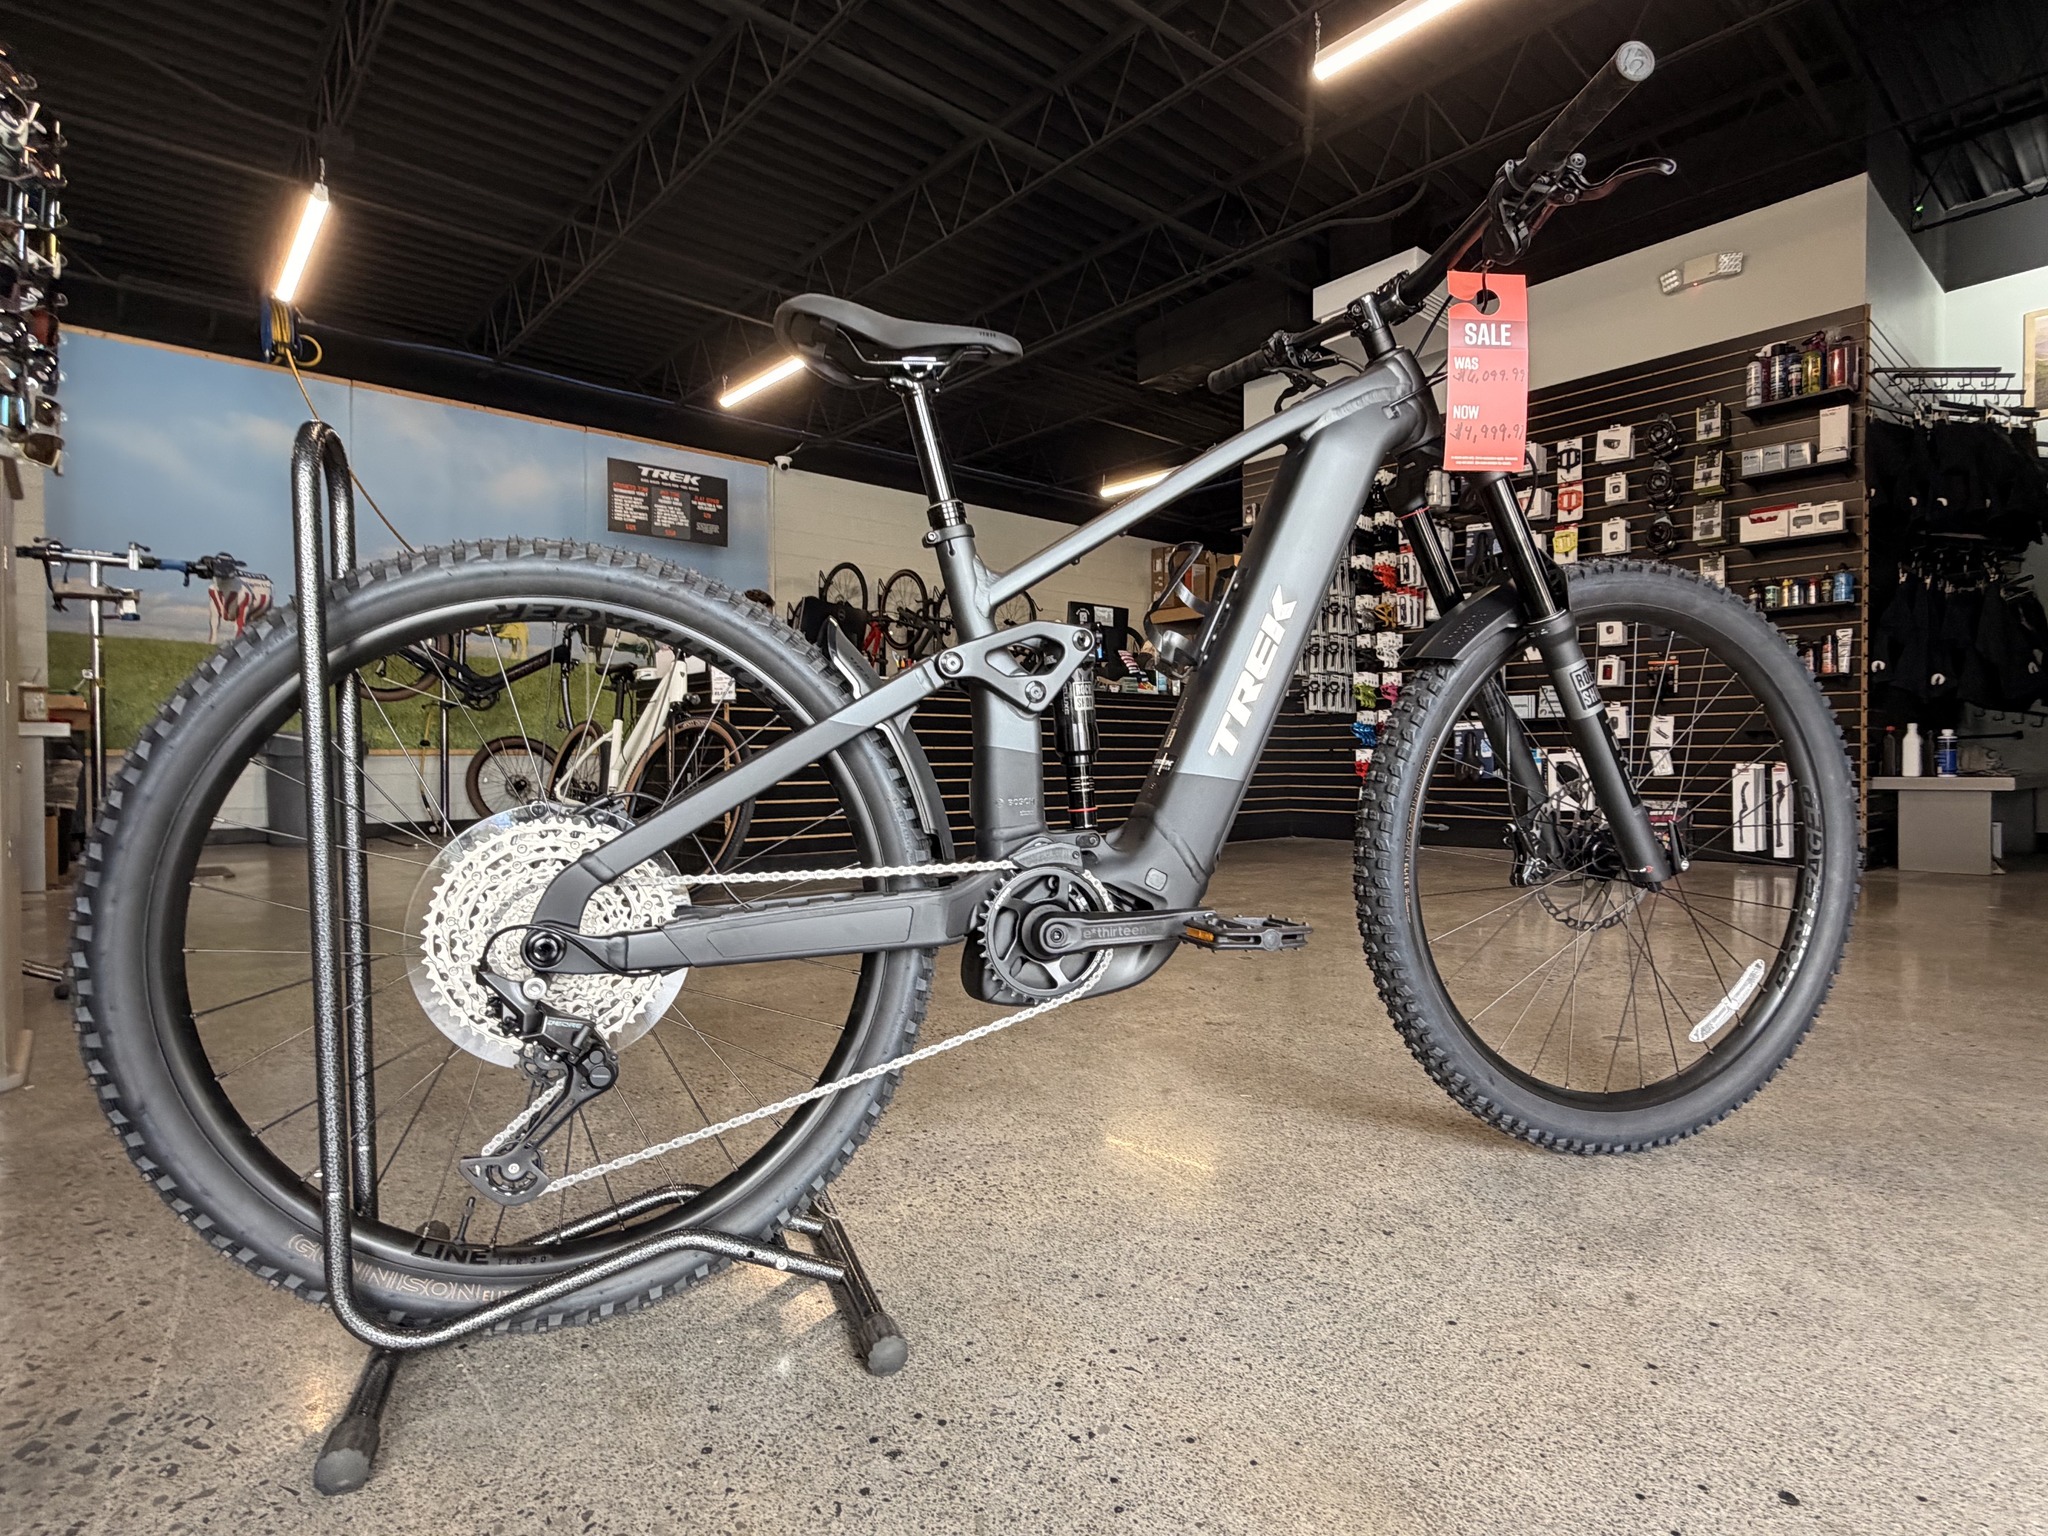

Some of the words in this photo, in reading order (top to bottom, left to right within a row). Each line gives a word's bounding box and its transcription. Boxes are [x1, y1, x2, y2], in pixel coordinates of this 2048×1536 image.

[1464, 322, 1512, 346] SALE
[1453, 356, 1479, 370] WAS
[1453, 404, 1480, 419] NOW
[637, 465, 702, 486] TREK
[1208, 584, 1297, 757] TREK
[1575, 667, 1595, 688] RO
[1581, 686, 1601, 706] SH
[412, 1239, 490, 1265] LINE
